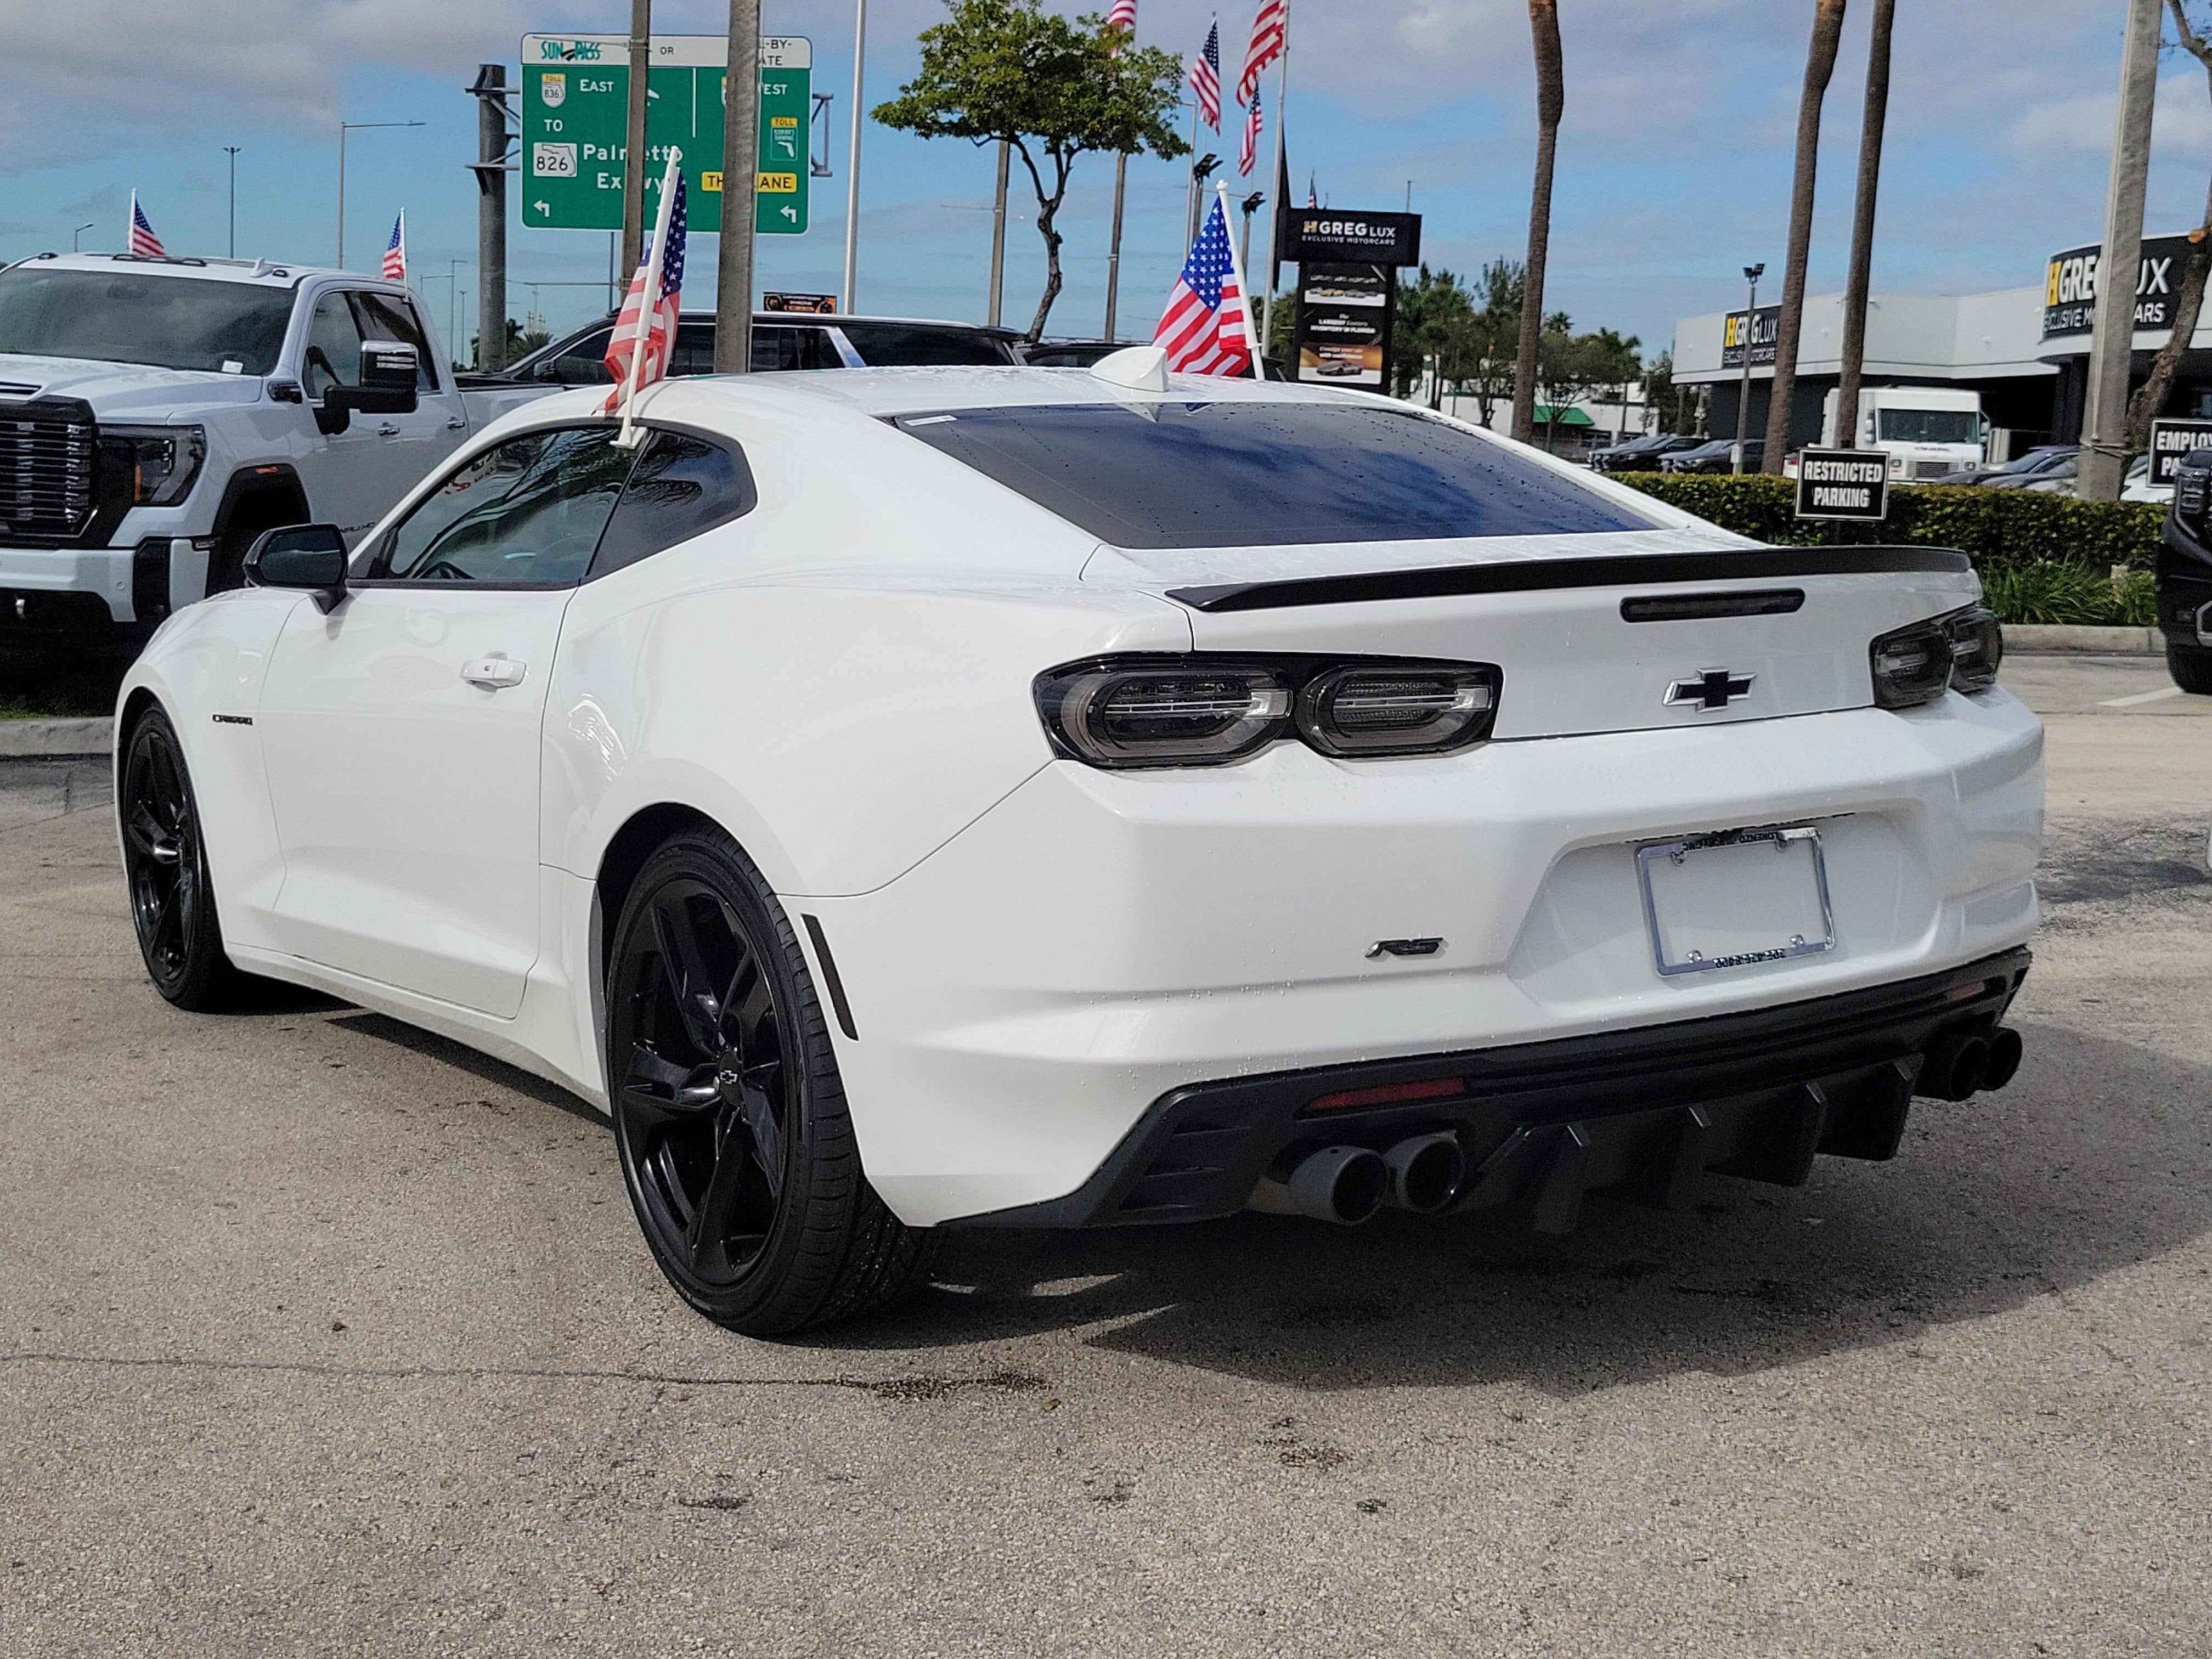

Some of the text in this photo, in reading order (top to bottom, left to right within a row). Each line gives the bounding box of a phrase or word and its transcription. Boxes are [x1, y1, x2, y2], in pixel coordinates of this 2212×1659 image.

[660, 47, 674, 55] OR
[579, 78, 614, 93] EAST
[763, 83, 788, 95] EST
[544, 119, 563, 132] TO
[774, 117, 794, 126] TOLL
[536, 156, 568, 171] 826
[760, 177, 792, 189] ANE
[1804, 461, 1884, 483] RESTRICTED
[1813, 487, 1871, 508] PARKING
